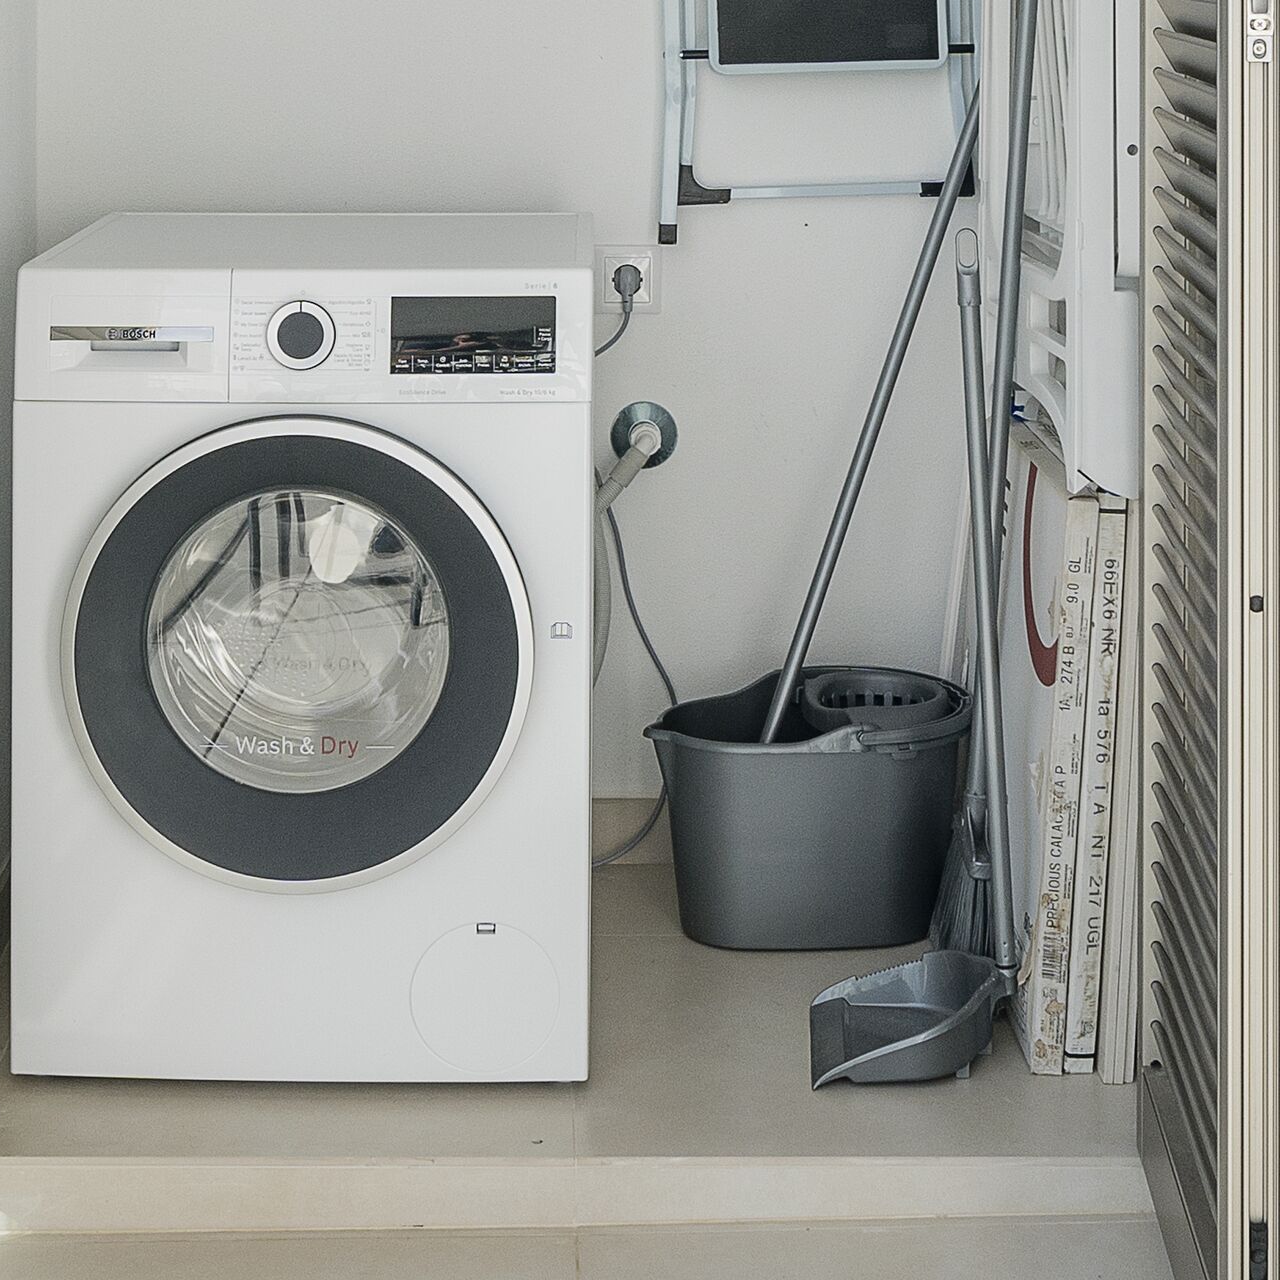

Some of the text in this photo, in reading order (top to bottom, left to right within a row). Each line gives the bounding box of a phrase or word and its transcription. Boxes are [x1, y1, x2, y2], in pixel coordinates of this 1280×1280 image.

[122, 329, 156, 339] BOSCH
[1068, 557, 1081, 573] GL
[1066, 583, 1079, 603] 9.0
[1062, 645, 1075, 655] B
[1101, 628, 1117, 658] NR
[1060, 660, 1074, 684] 274
[236, 734, 359, 759] Wash & Dry
[1096, 729, 1112, 763] 576
[1055, 765, 1066, 775] P
[1093, 802, 1107, 815] A
[1091, 835, 1106, 861] NT
[1046, 863, 1061, 929] PRECIOUS
[1088, 875, 1103, 907] 217
[1086, 916, 1101, 955] UGL
